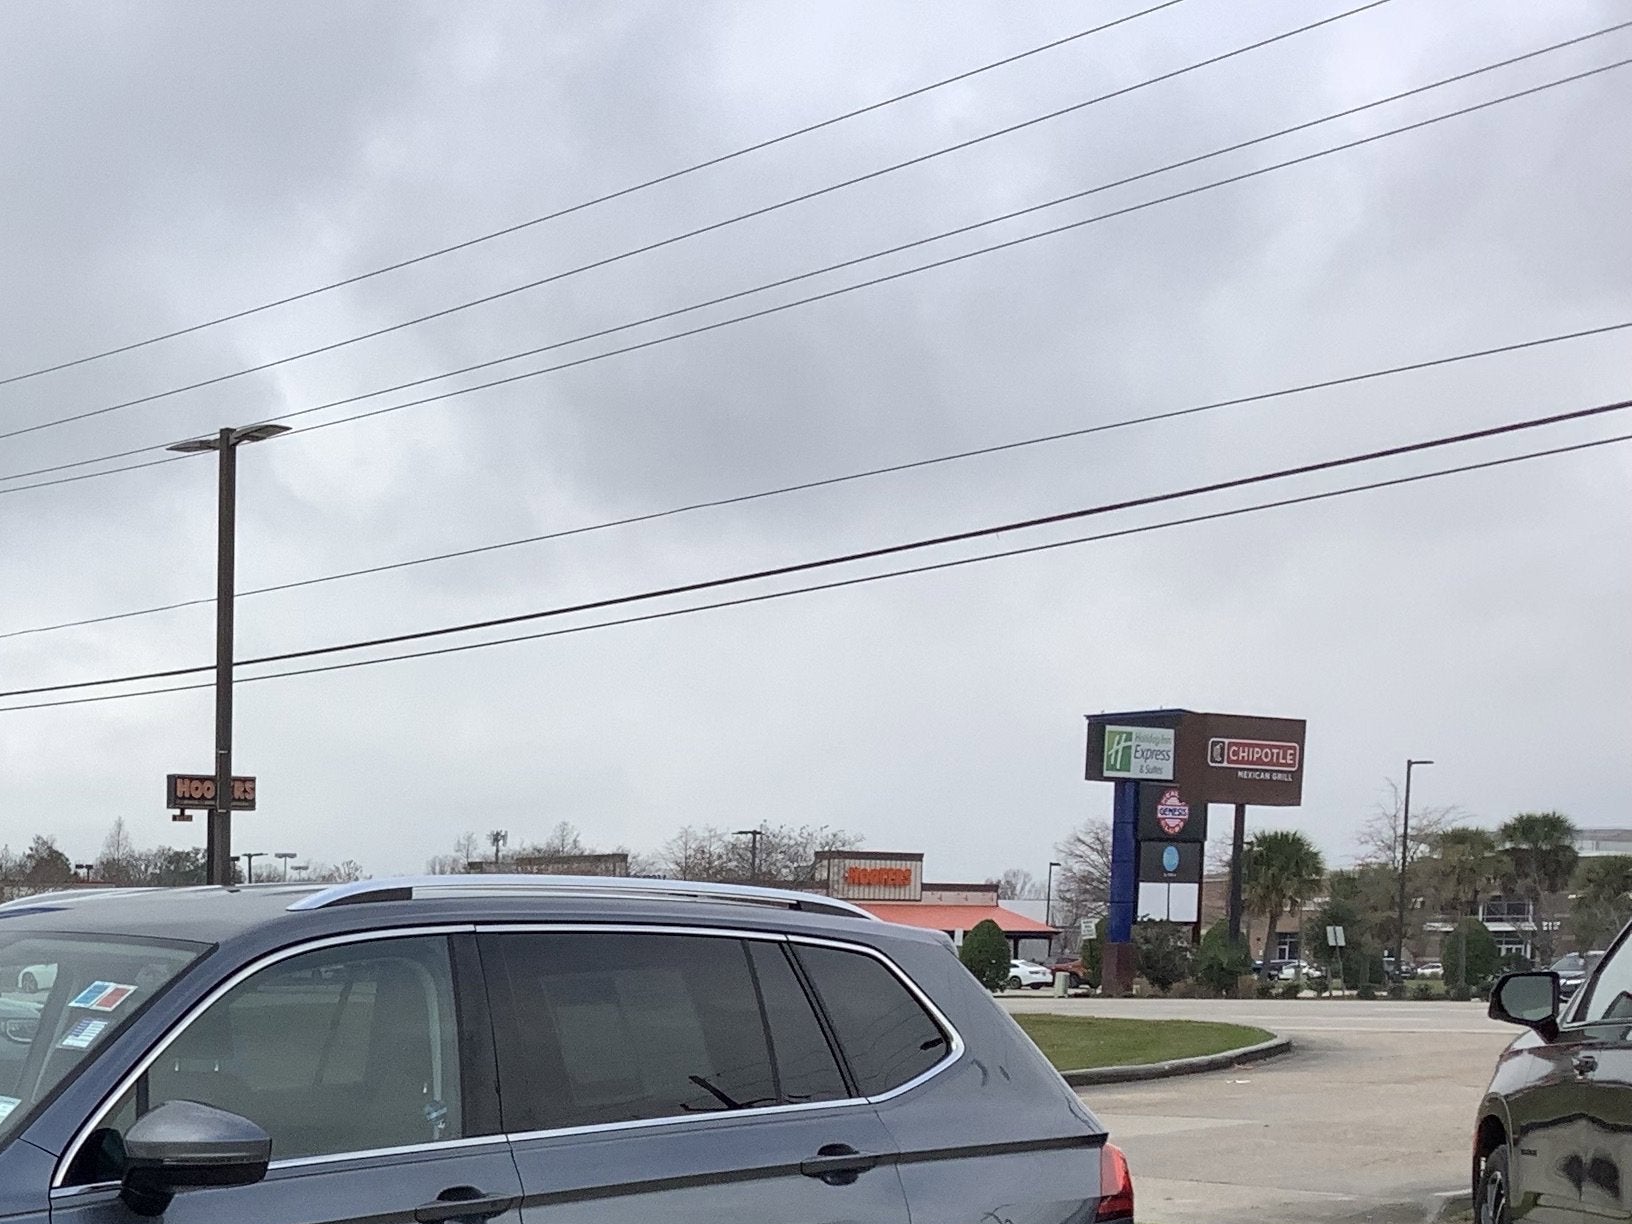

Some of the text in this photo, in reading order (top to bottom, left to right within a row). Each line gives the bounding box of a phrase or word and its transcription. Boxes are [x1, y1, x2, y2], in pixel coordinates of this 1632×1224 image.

[1133, 744, 1172, 763] Express
[1229, 746, 1295, 764] CHIPOTLE
[1237, 770, 1293, 782] MEXICAN GRILL
[176, 778, 255, 800] HOORS
[1159, 807, 1187, 817] GENESIS
